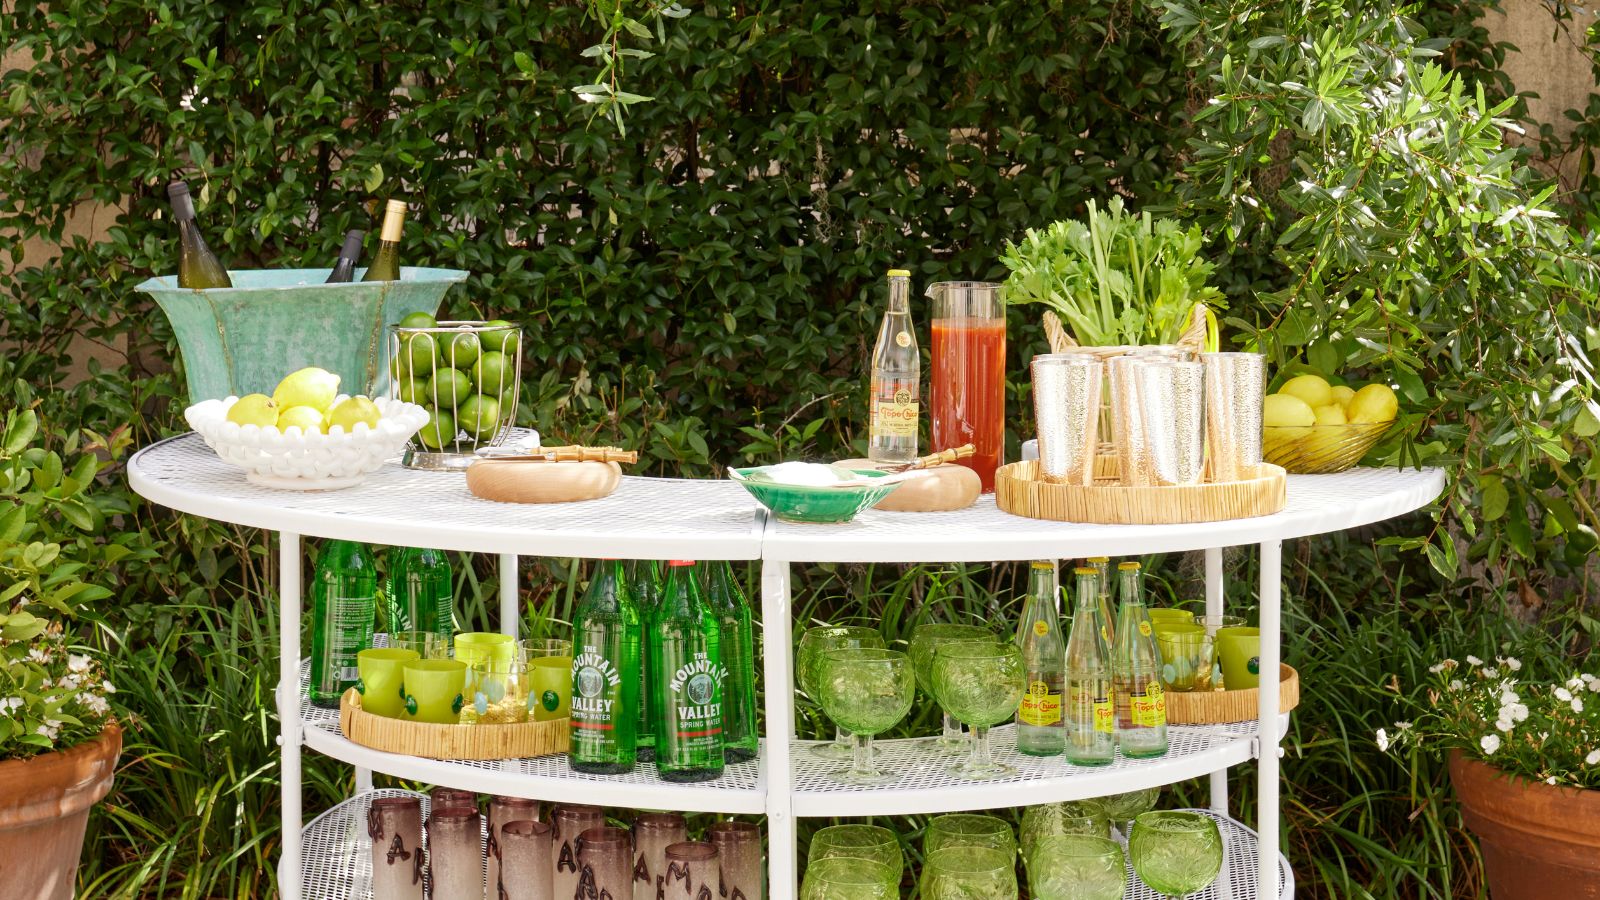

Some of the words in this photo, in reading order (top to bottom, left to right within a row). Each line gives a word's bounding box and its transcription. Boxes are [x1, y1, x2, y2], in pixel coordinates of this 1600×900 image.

[584, 645, 597, 653] THE
[693, 652, 708, 660] THE
[572, 695, 613, 713] VALLEY
[1039, 700, 1058, 712] Chico
[590, 713, 611, 721] WATER
[678, 703, 721, 720] VALLEY
[680, 720, 704, 729] SPRING
[706, 717, 721, 727] WATER
